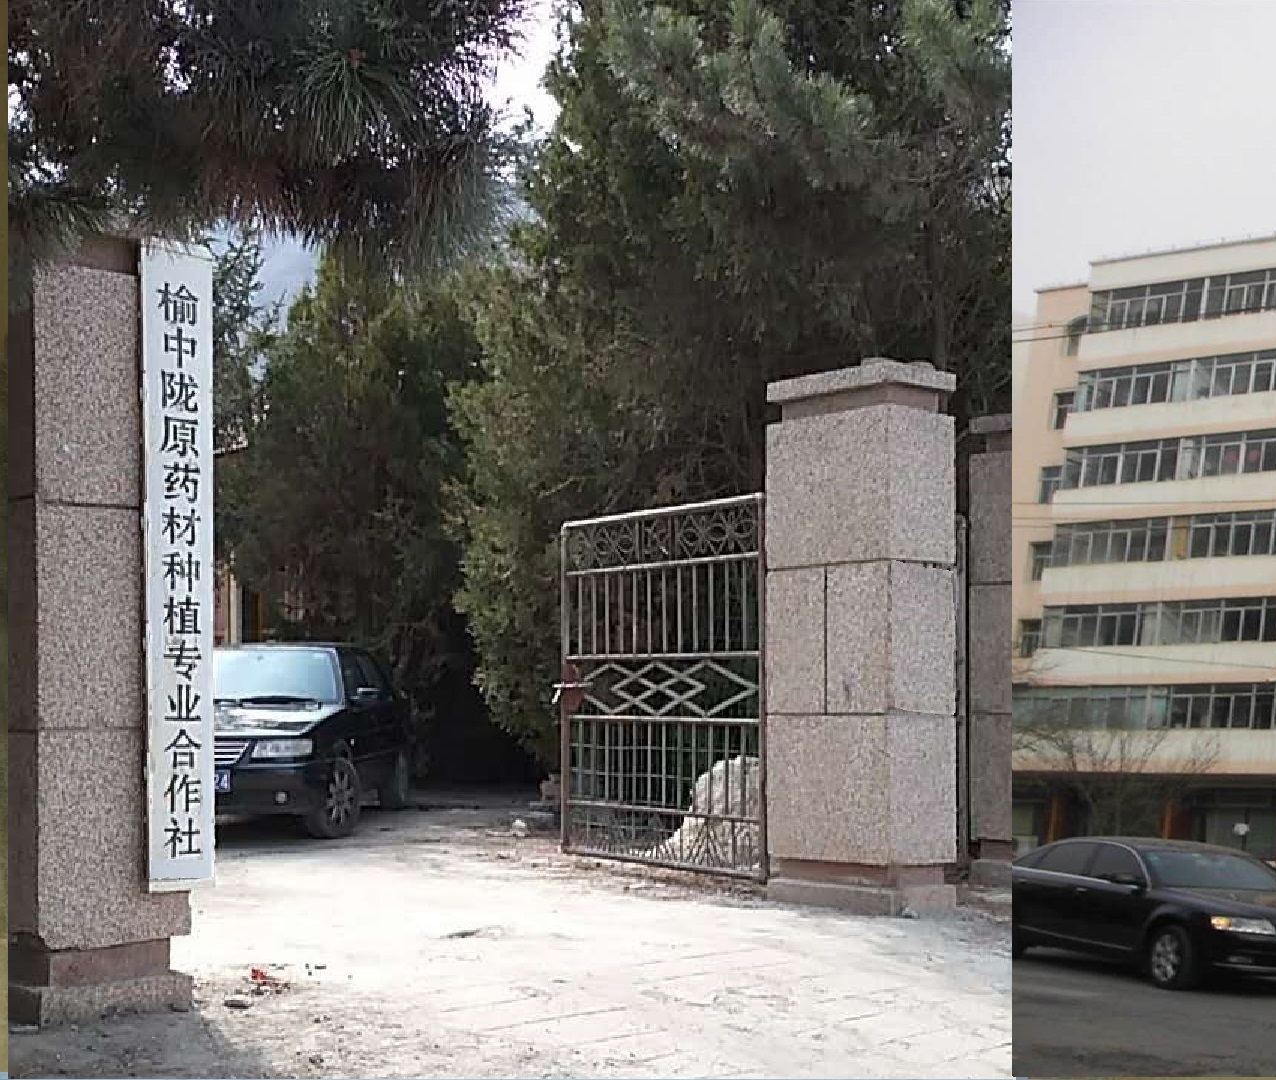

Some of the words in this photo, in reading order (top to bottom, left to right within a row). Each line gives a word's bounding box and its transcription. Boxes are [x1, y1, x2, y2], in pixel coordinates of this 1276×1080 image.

[156, 281, 203, 859] 榆中陇原药材种植专业合作社
